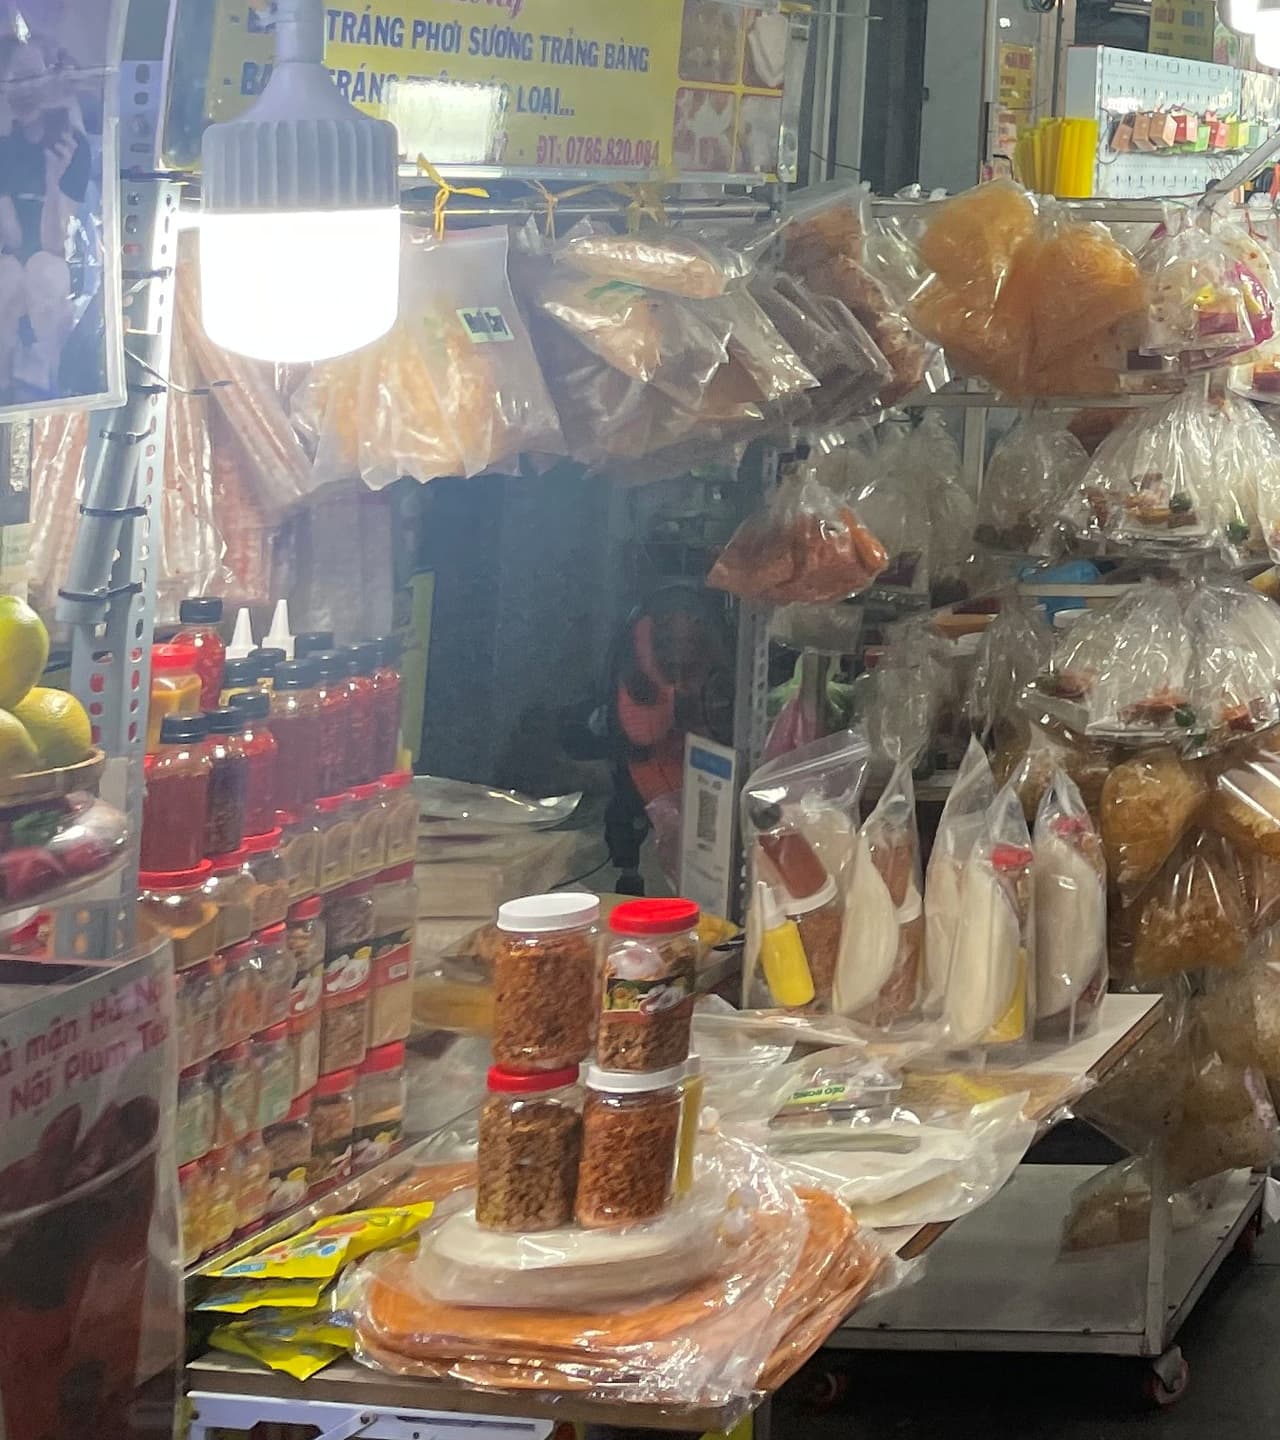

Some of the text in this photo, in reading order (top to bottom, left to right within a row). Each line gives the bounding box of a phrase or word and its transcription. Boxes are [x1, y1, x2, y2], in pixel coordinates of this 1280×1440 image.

[327, 5, 650, 73] TRÁNG PHƠI SƯƠNG TRẢNG BÀNG
